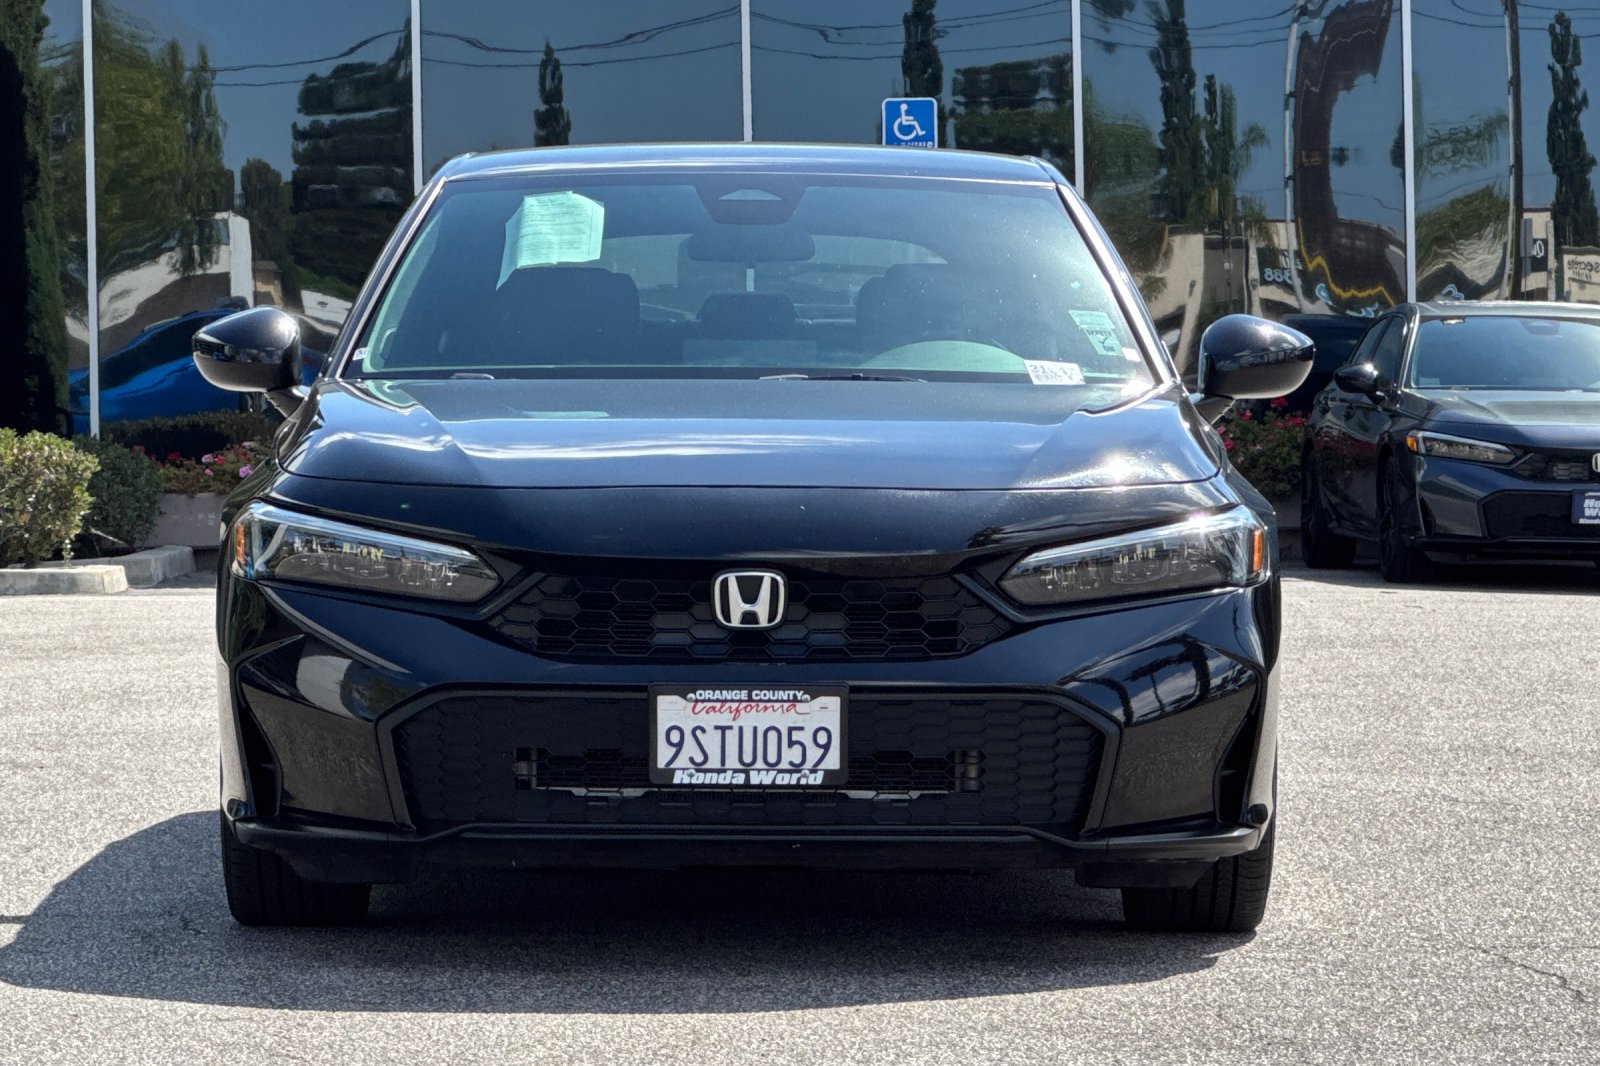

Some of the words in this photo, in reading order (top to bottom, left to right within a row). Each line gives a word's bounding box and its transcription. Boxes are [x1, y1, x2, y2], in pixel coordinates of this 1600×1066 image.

[1584, 507, 1600, 517] W
[695, 689, 748, 700] ORANGE
[752, 689, 805, 700] COUNTY
[691, 701, 811, 721] California
[664, 724, 832, 768] 9STU059
[672, 769, 746, 785] Honda
